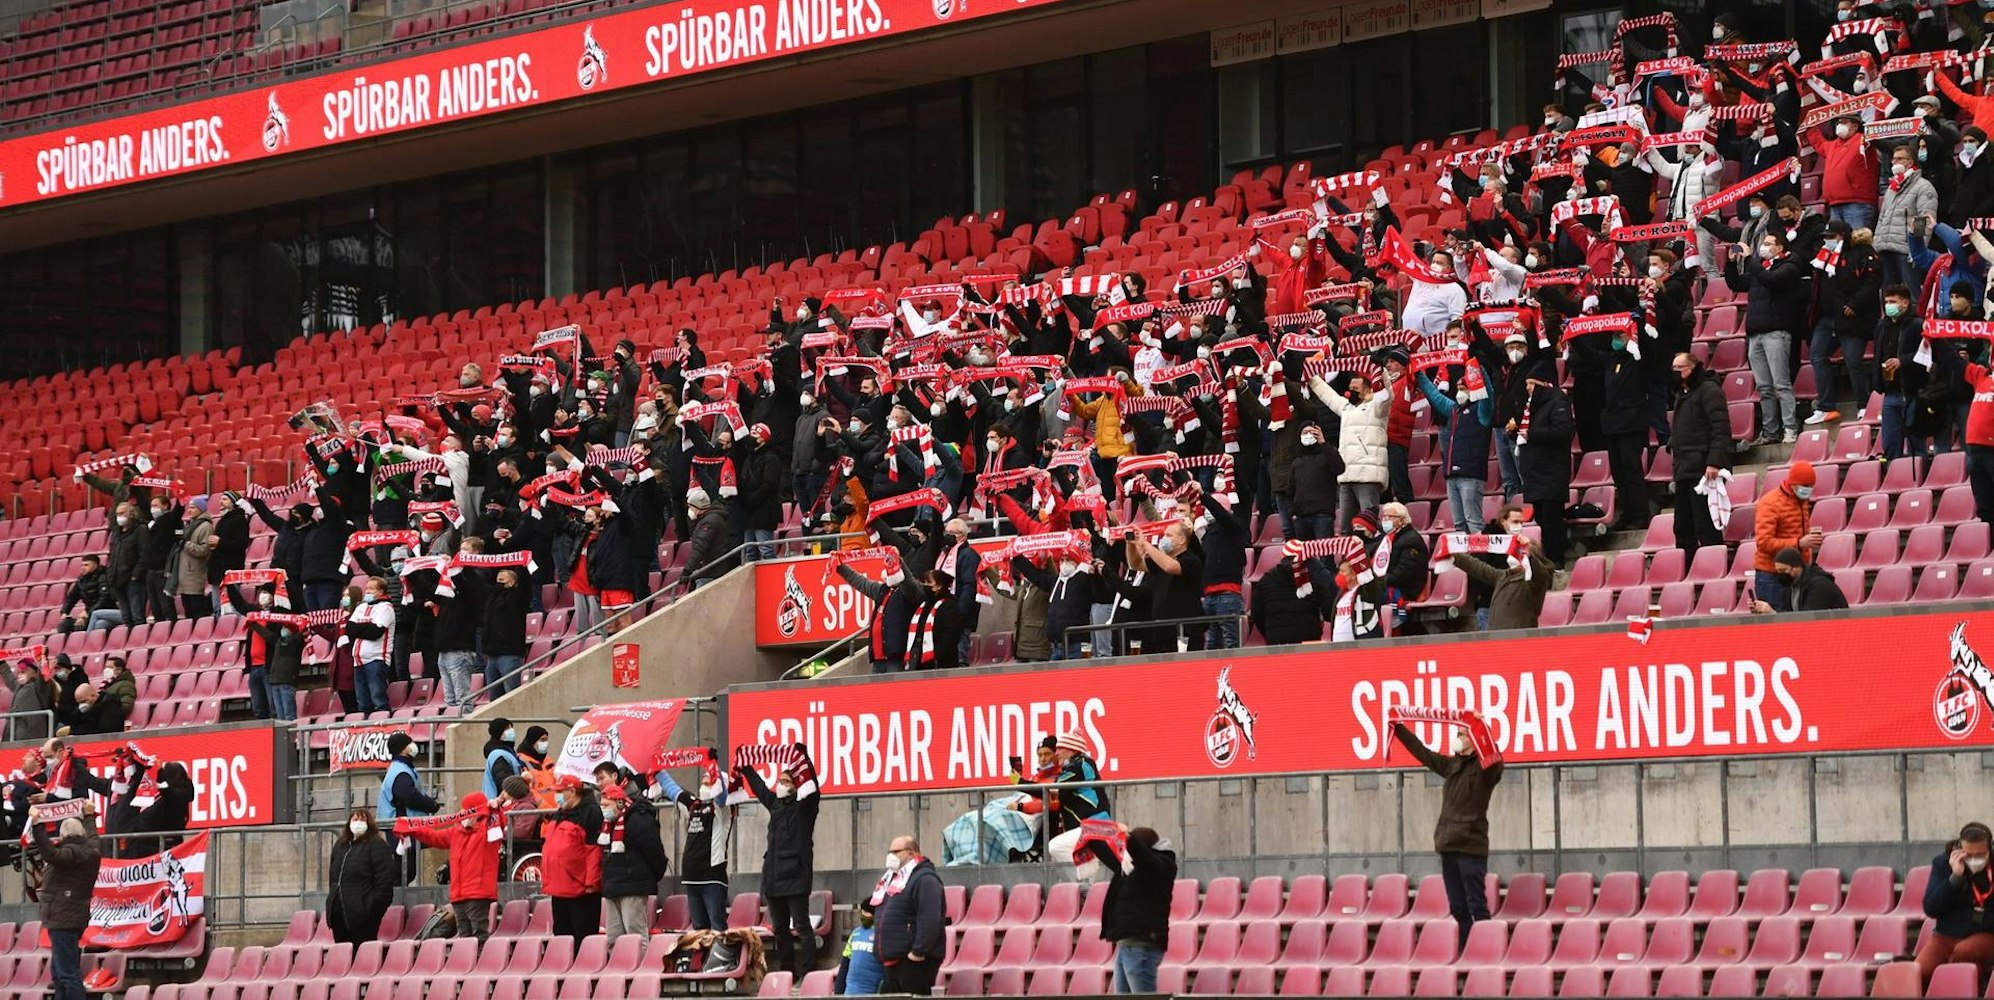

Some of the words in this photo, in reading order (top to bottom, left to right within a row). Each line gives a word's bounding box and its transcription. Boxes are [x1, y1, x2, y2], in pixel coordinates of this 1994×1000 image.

[645, 19, 766, 77] SPÜRBAR
[323, 73, 431, 141] SPÜRBAR
[437, 53, 539, 118] ANDERS.
[36, 133, 134, 195] SPÜRBAR
[138, 116, 230, 176] ANDERS.
[1632, 228, 1646, 237] FC
[1959, 320, 1991, 334] KÖL
[459, 551, 524, 563] HEIMVORTEIL
[1595, 656, 1819, 750] ANDERS.
[340, 729, 406, 763] HUNSRÜ
